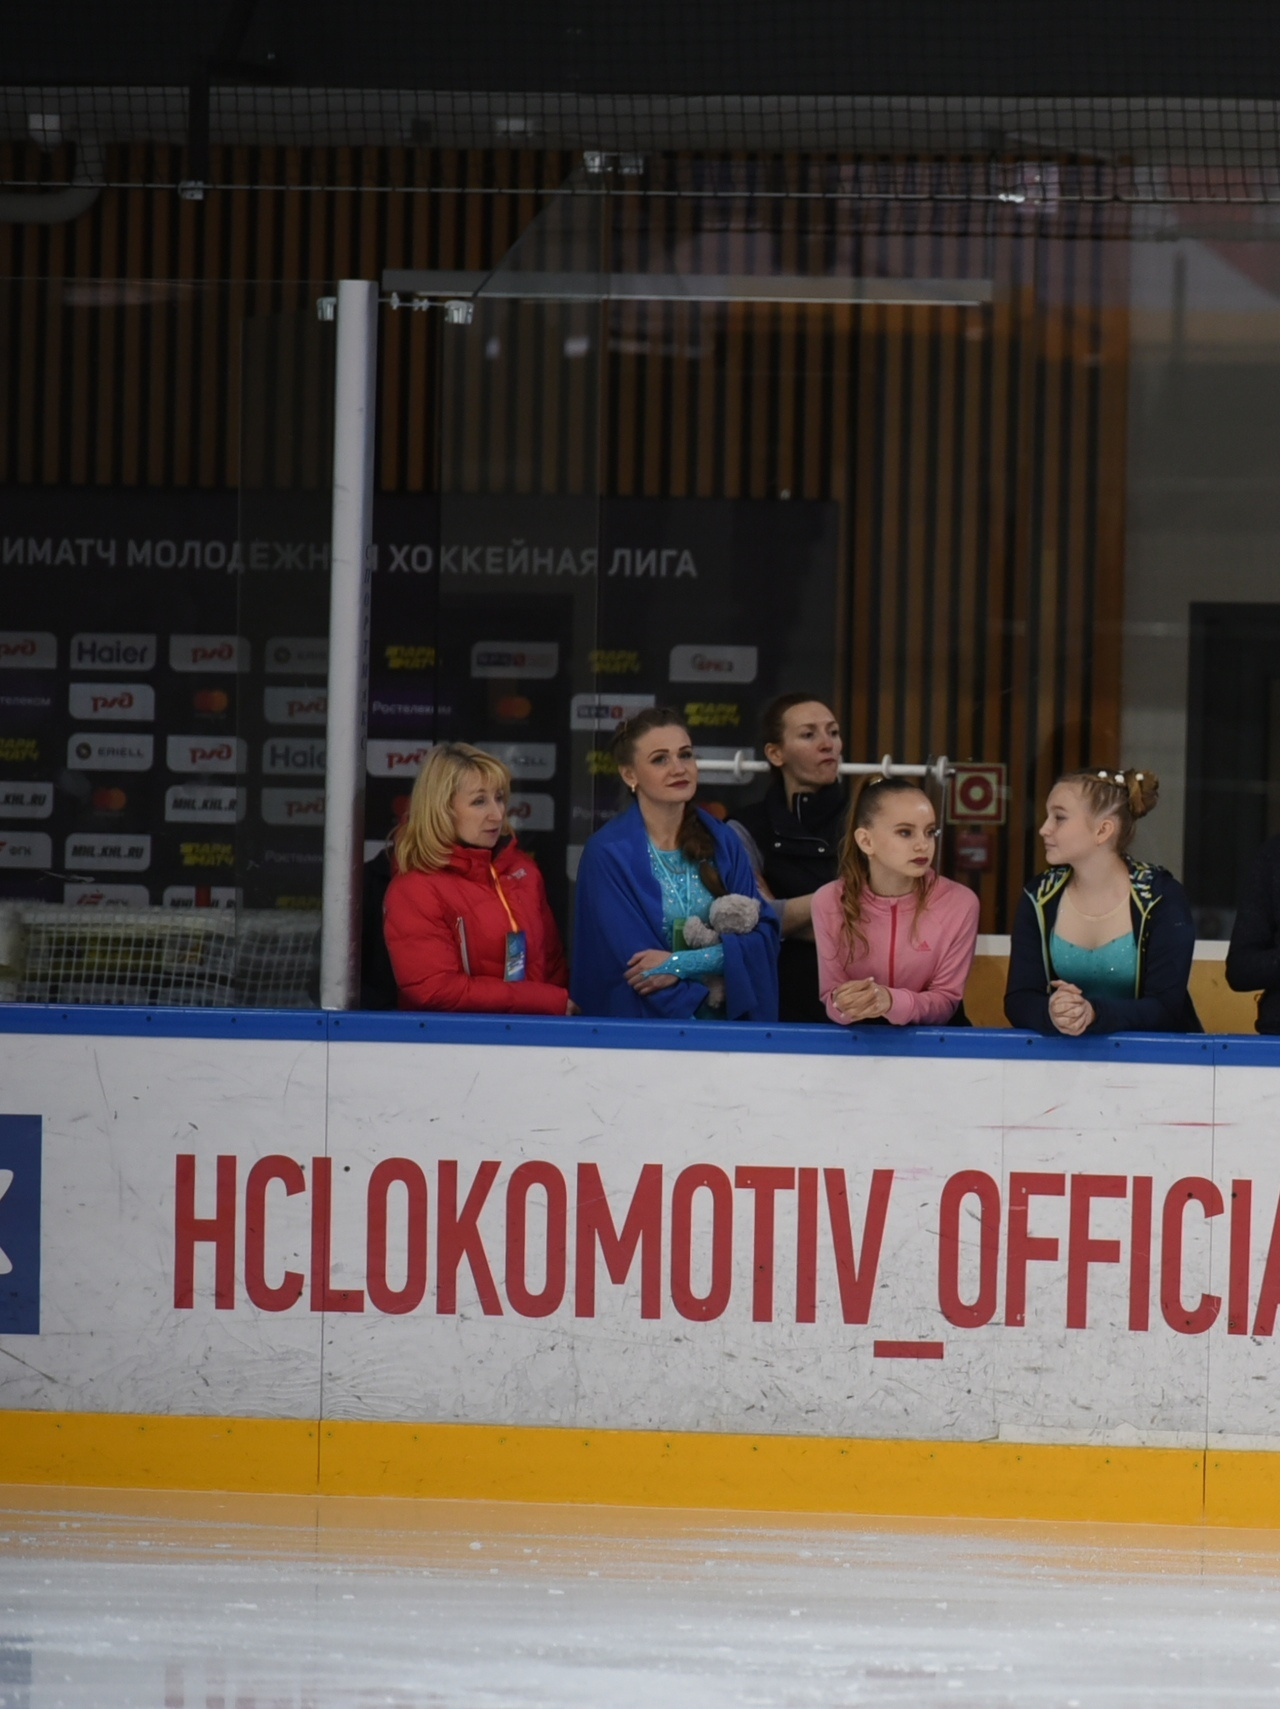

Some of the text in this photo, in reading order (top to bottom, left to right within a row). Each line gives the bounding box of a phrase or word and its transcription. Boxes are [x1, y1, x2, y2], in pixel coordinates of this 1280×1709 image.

[127, 539, 378, 574] МОЛОДЕЖН
[389, 538, 598, 575] ХОККЕЙНАЯ
[608, 548, 698, 578] ЛИГА
[77, 640, 148, 664] Haier
[270, 745, 327, 769] Haie
[71, 844, 145, 859] MHL.KHL.RU
